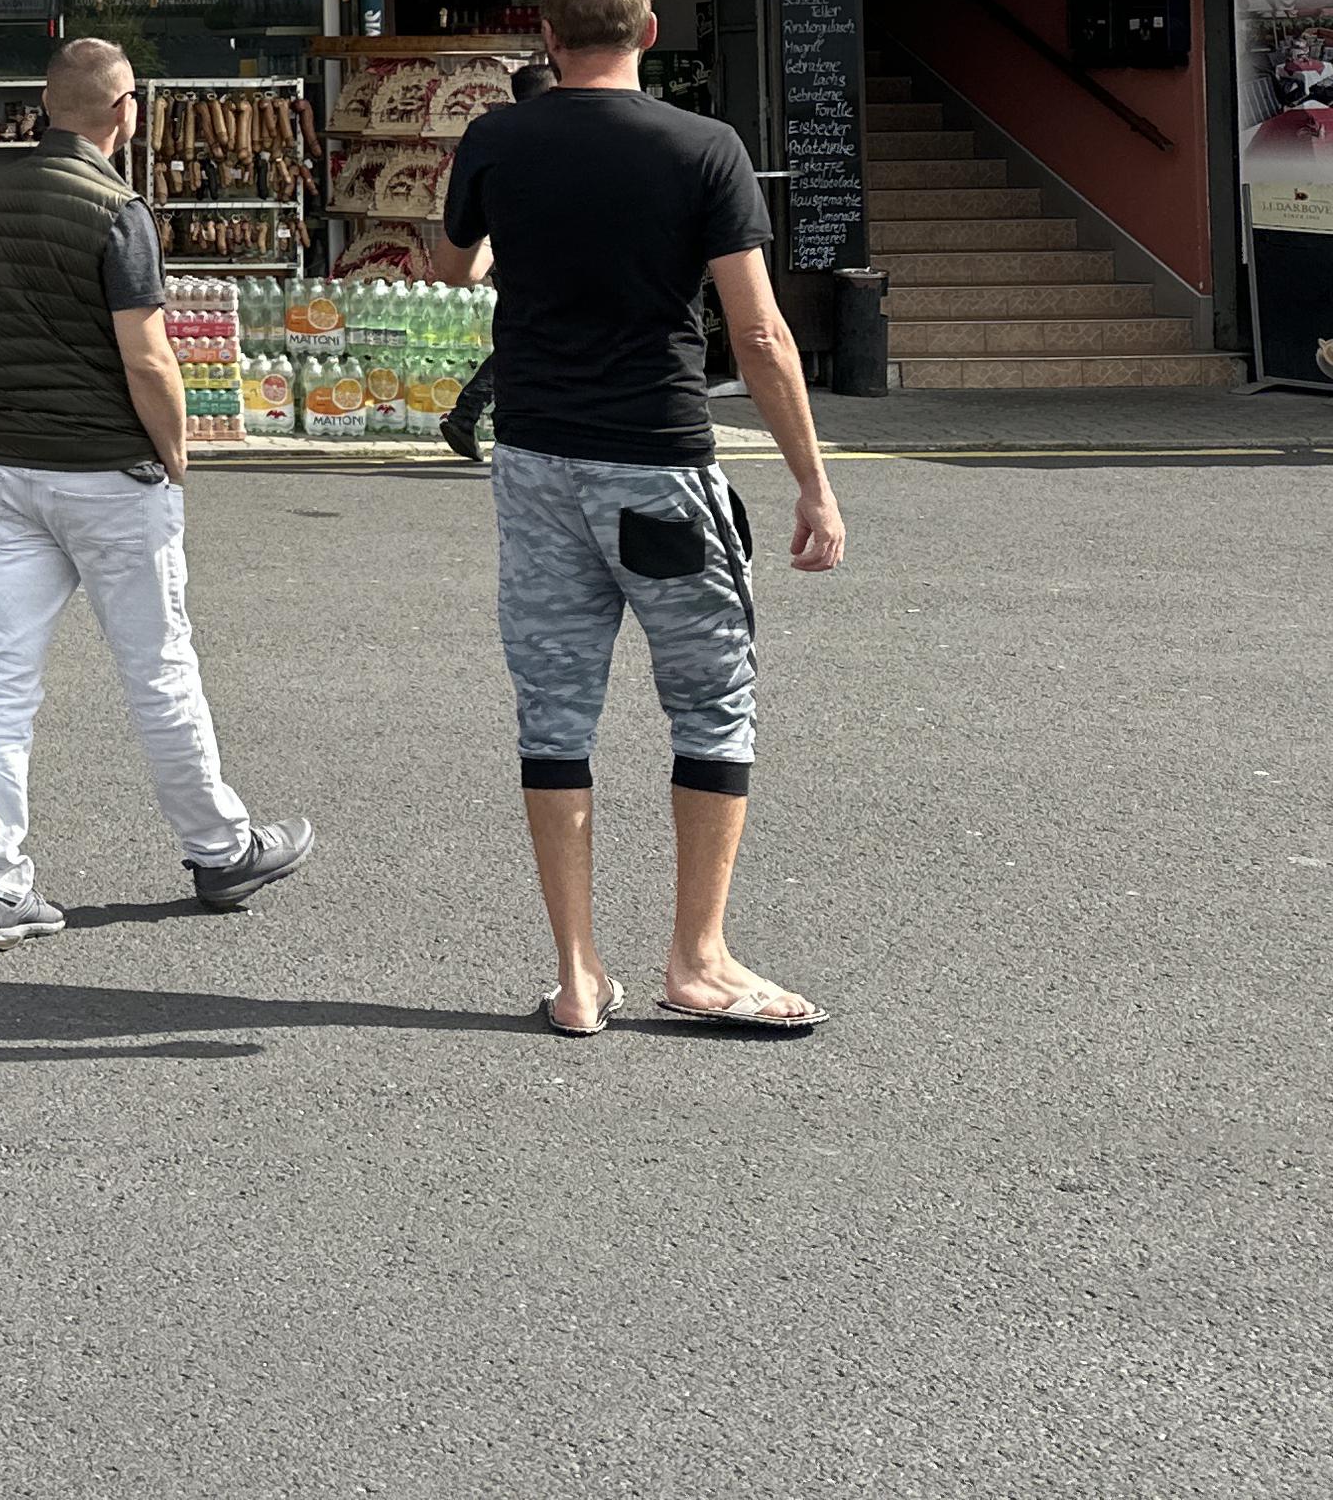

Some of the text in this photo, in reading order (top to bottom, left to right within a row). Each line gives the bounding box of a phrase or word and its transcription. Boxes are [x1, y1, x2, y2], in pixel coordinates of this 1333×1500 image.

[813, 73, 847, 87] Lachs
[815, 102, 856, 118] Forelle
[788, 119, 852, 137] Eisbecher
[288, 333, 341, 347] MATTONI
[312, 414, 366, 427] MATTONI
